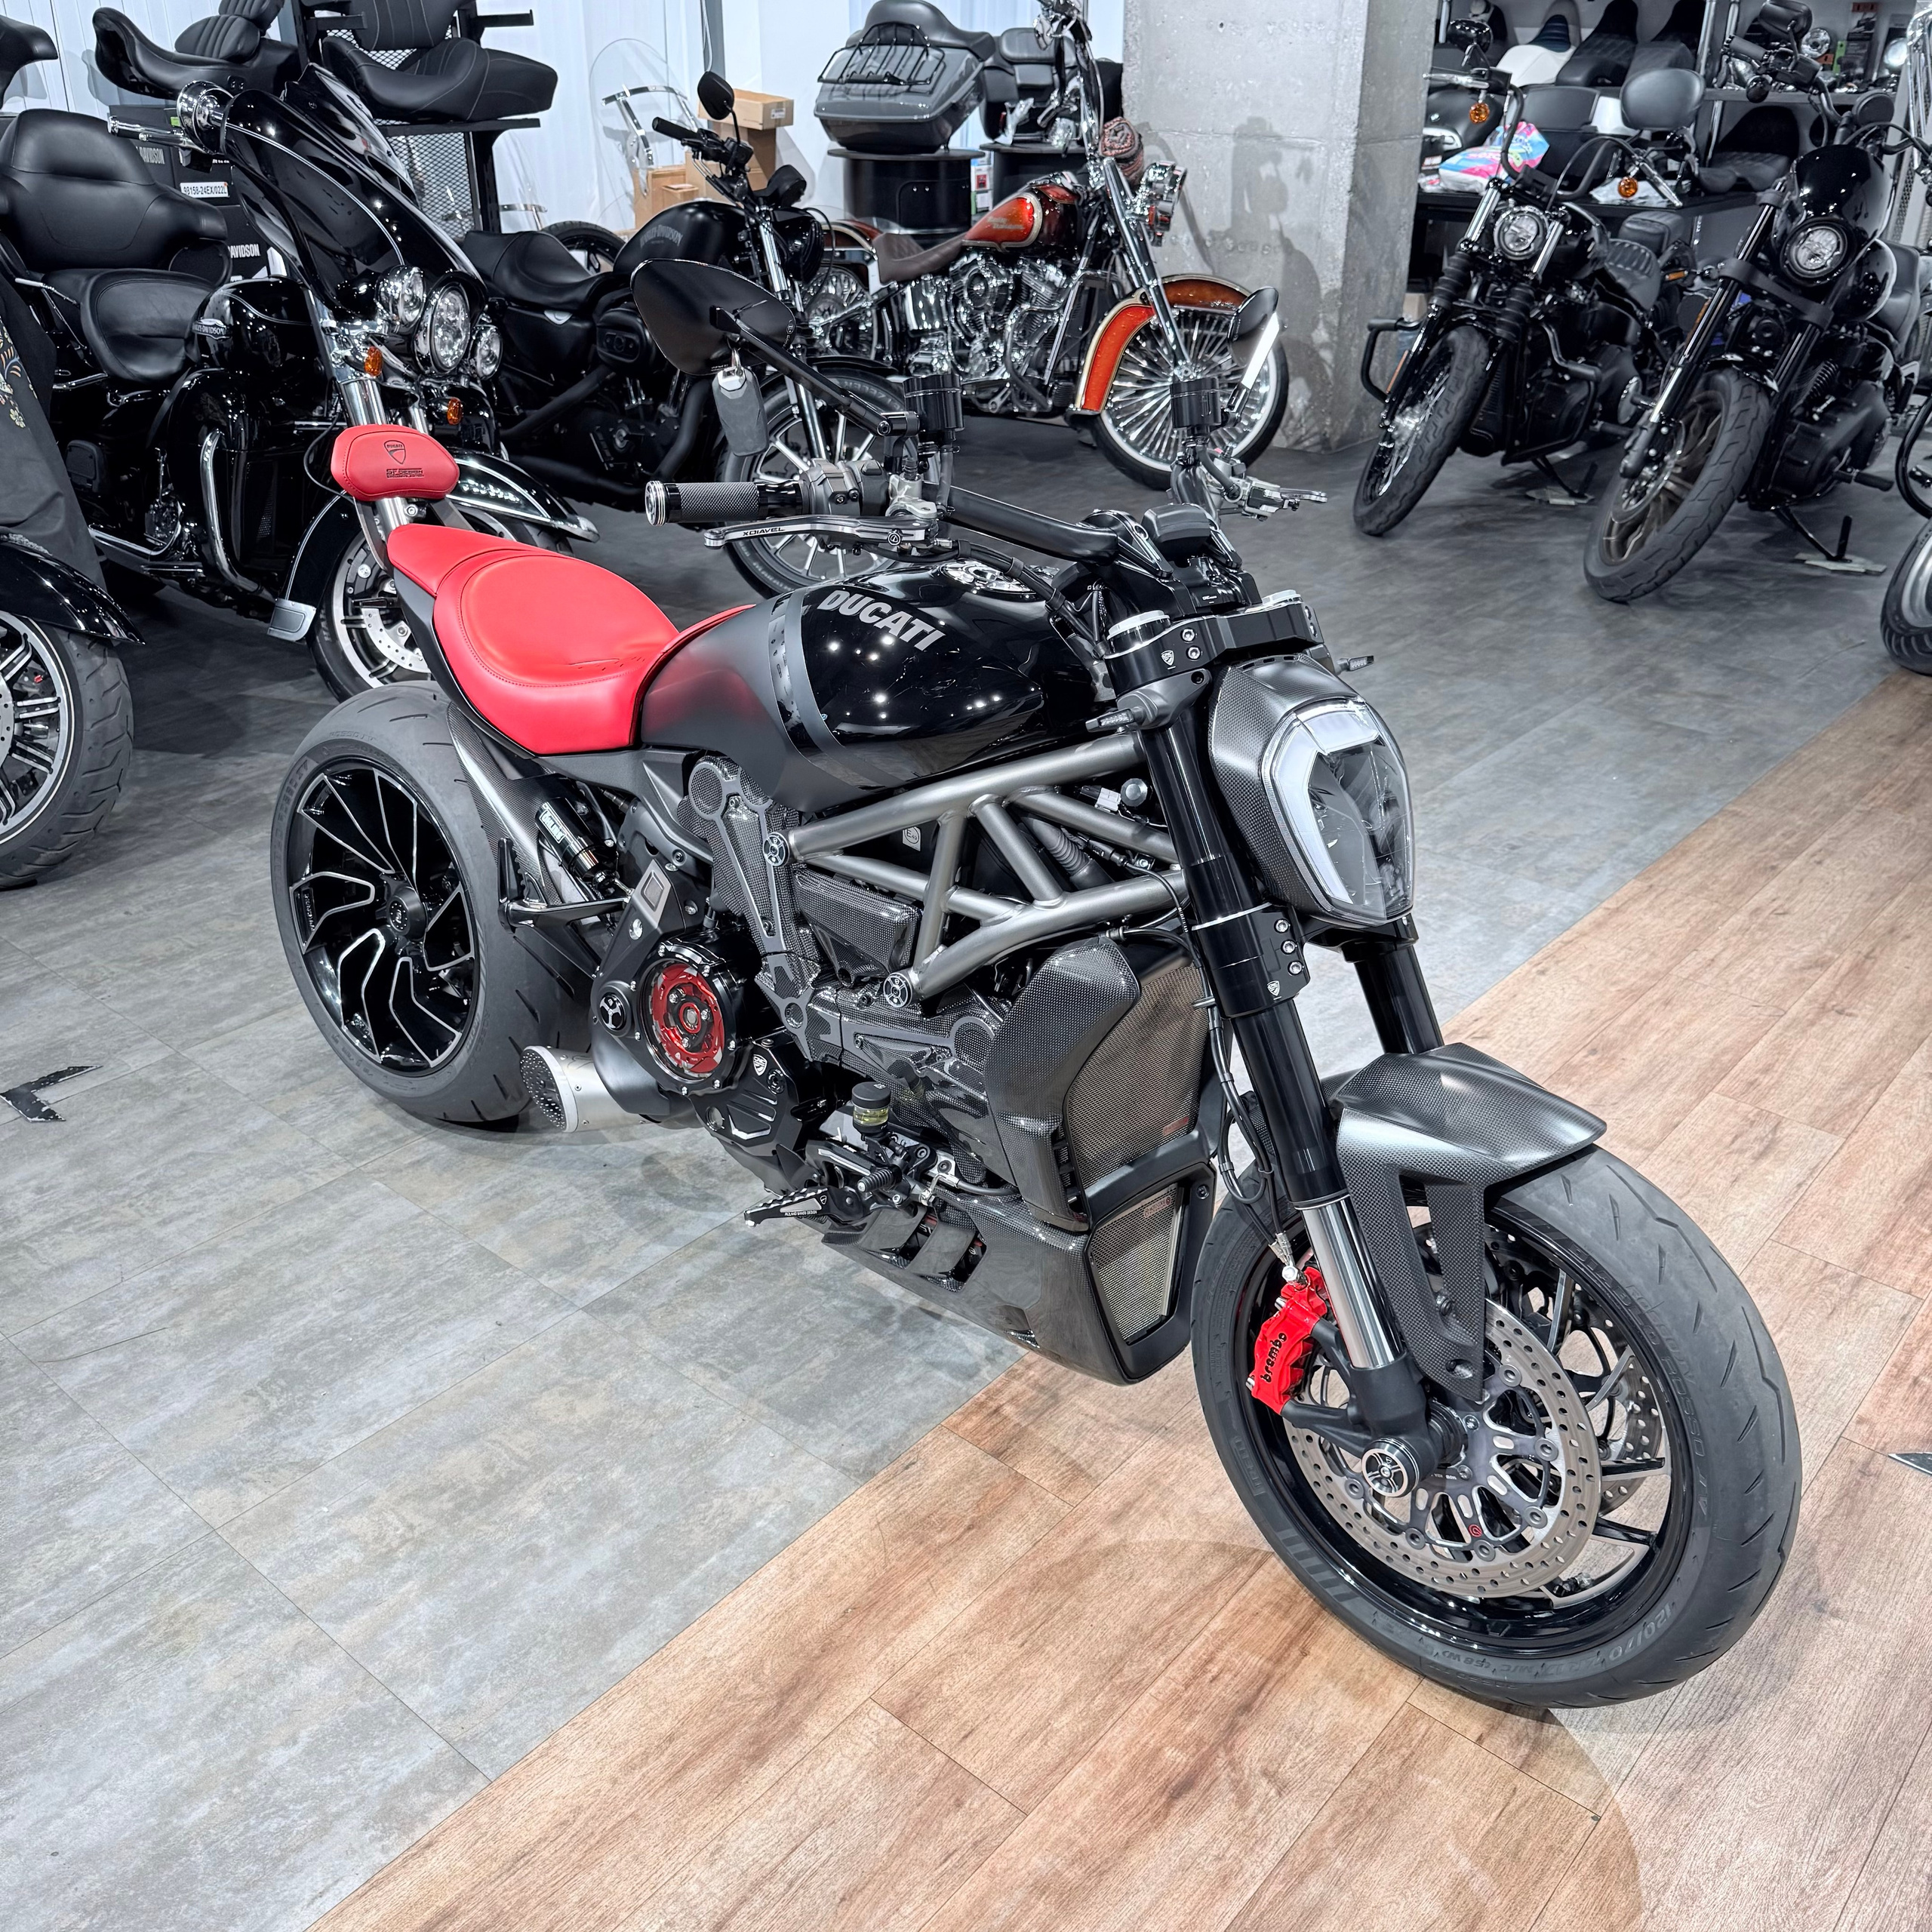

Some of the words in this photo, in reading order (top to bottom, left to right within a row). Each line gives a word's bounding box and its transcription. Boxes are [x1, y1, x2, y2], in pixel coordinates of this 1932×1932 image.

[843, 380, 904, 411] ETZELER
[743, 527, 786, 537] XDIAVEL
[817, 589, 946, 651] DUCATI
[1260, 1333, 1287, 1383] brembo
[1569, 1247, 1659, 1346] DIABLO
[1662, 1357, 1705, 1457] ROSSO
[1609, 1602, 1672, 1660] 120/70
